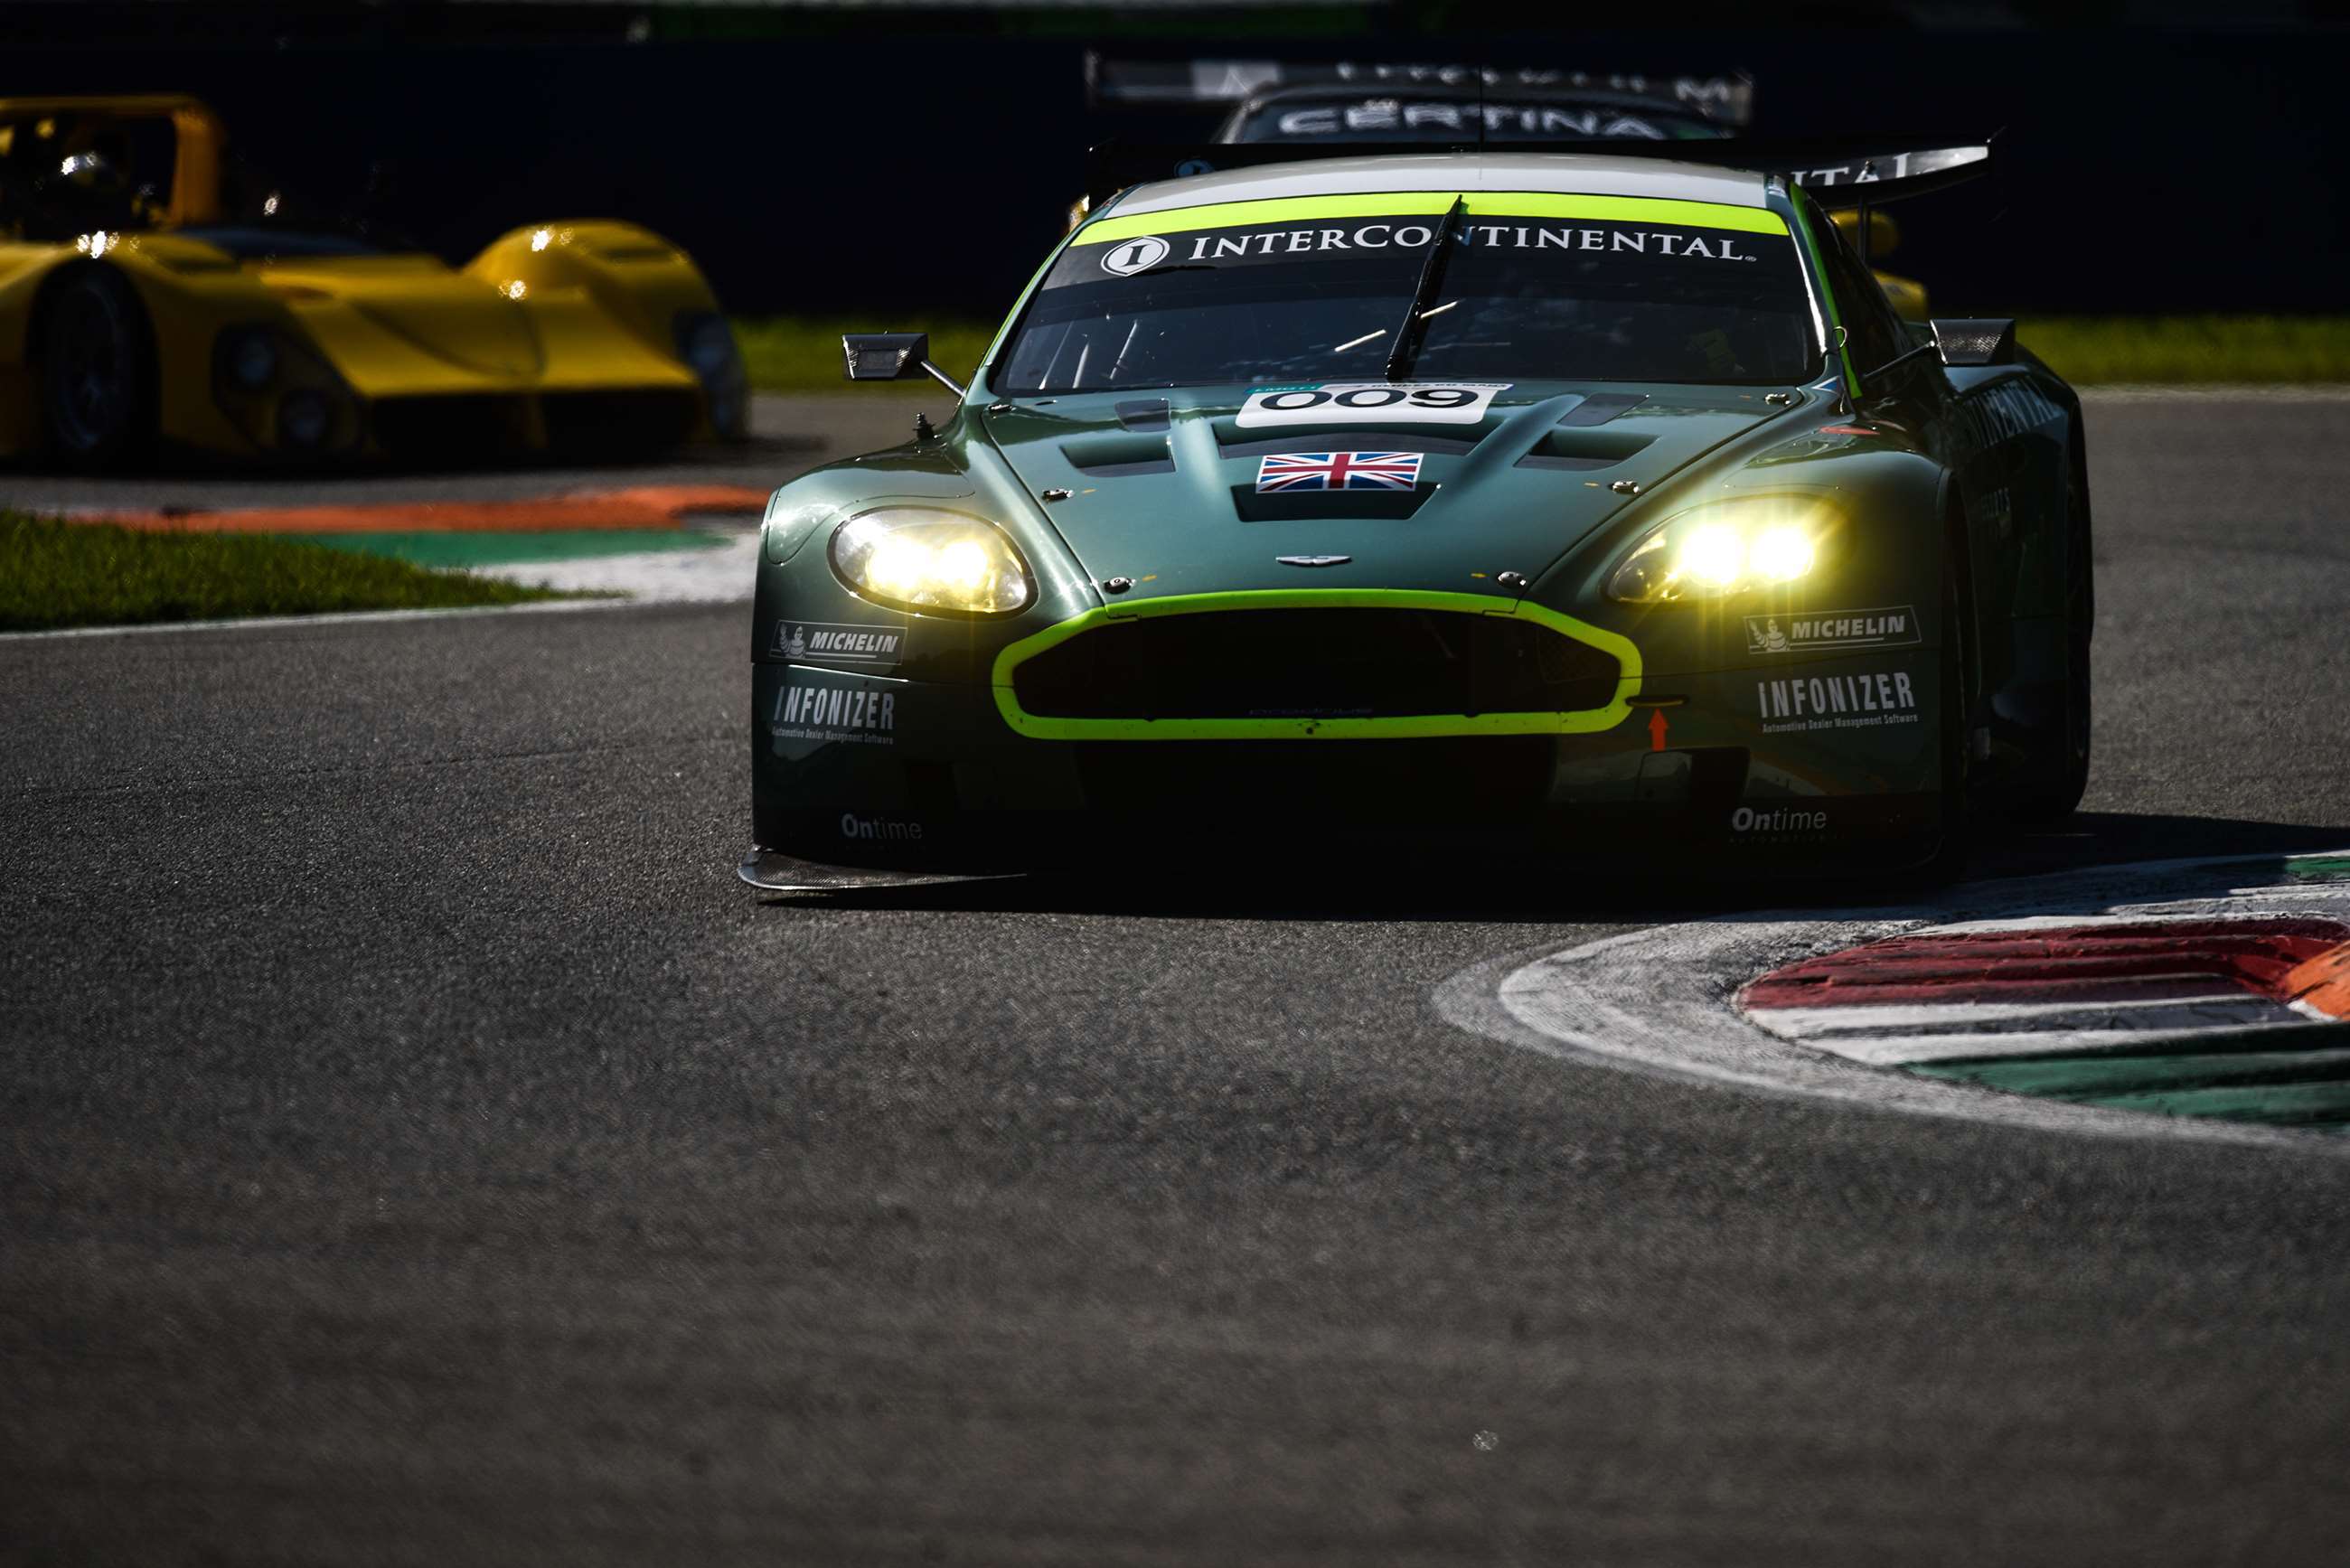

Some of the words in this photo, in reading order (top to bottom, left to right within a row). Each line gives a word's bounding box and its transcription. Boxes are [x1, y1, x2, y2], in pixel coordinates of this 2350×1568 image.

[1277, 101, 1666, 141] CERTINA
[1260, 389, 1479, 409] 009
[1791, 615, 1905, 639] MICHELIN
[809, 631, 898, 653] MICHELIN
[1758, 671, 1915, 718] INFONIZER
[773, 686, 896, 730] INFONIZER
[840, 812, 923, 839] Ontime
[1732, 807, 1828, 831] Ontime
